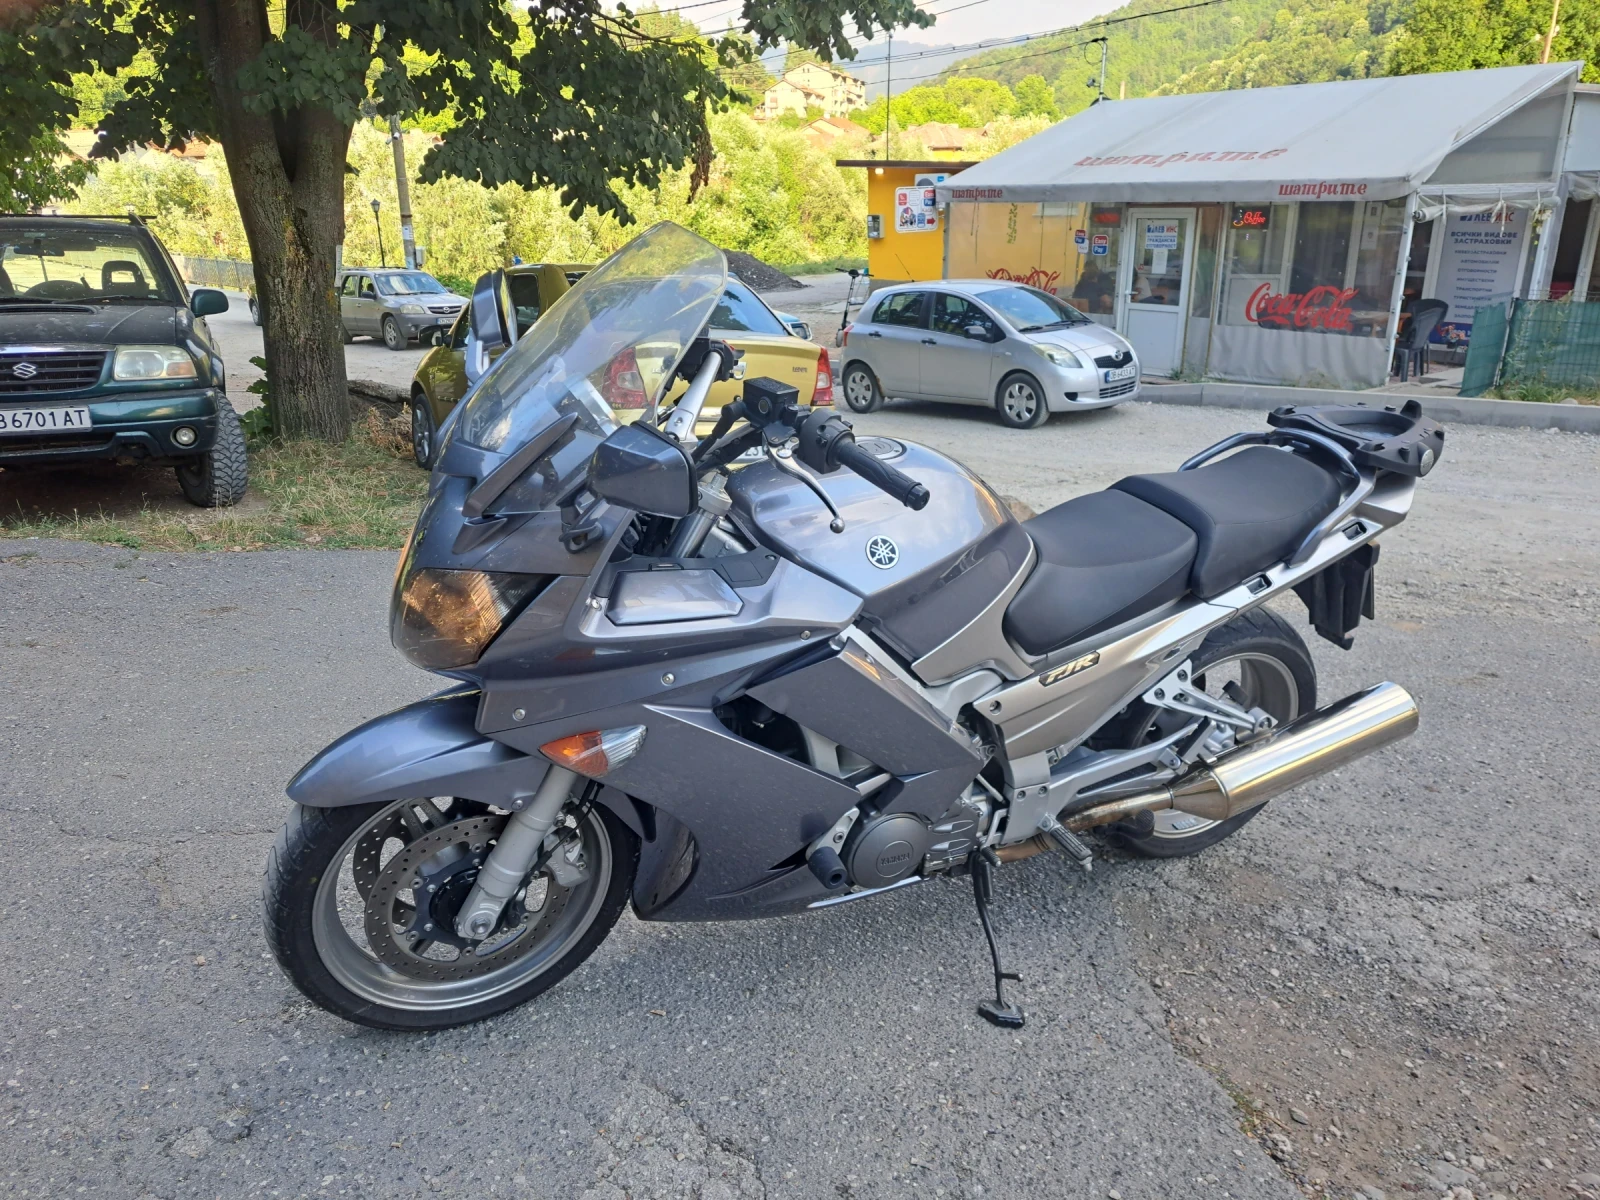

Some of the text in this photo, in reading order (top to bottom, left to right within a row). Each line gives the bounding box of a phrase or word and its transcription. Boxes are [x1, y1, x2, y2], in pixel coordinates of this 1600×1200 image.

[1278, 181, 1367, 199] шатрите
[1245, 282, 1360, 330] Coca-Cola
[880, 852, 910, 866] YAMAHA
